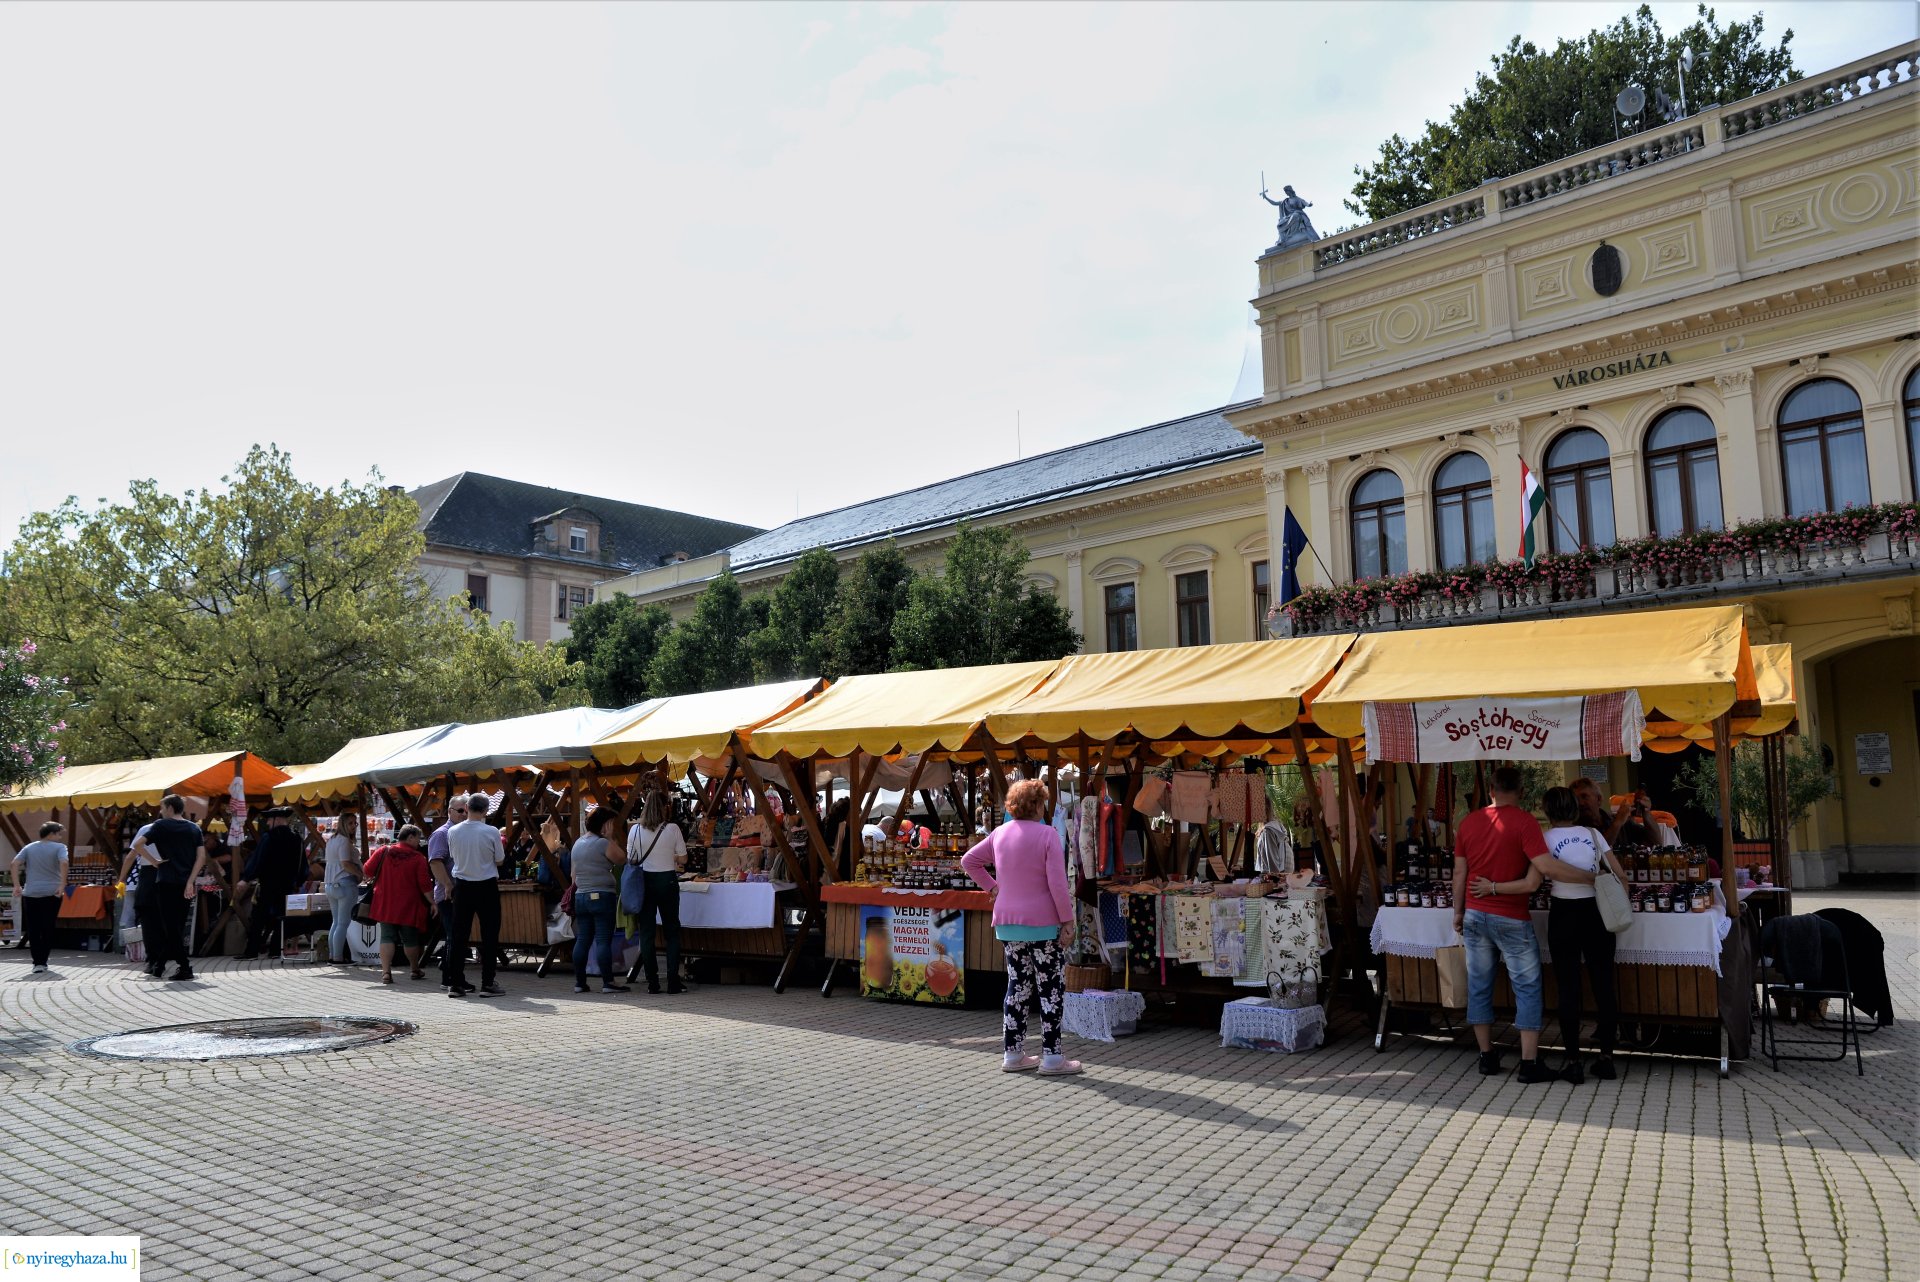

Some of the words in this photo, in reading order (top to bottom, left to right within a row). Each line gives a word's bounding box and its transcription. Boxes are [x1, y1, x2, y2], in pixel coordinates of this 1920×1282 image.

[1553, 350, 1672, 389] VÁROSHÁZA
[1420, 704, 1451, 729] Lekvárok
[1444, 707, 1549, 749] Sóstóhegy
[894, 926, 929, 935] MAGYAR
[894, 944, 929, 955] MÉZZEL!
